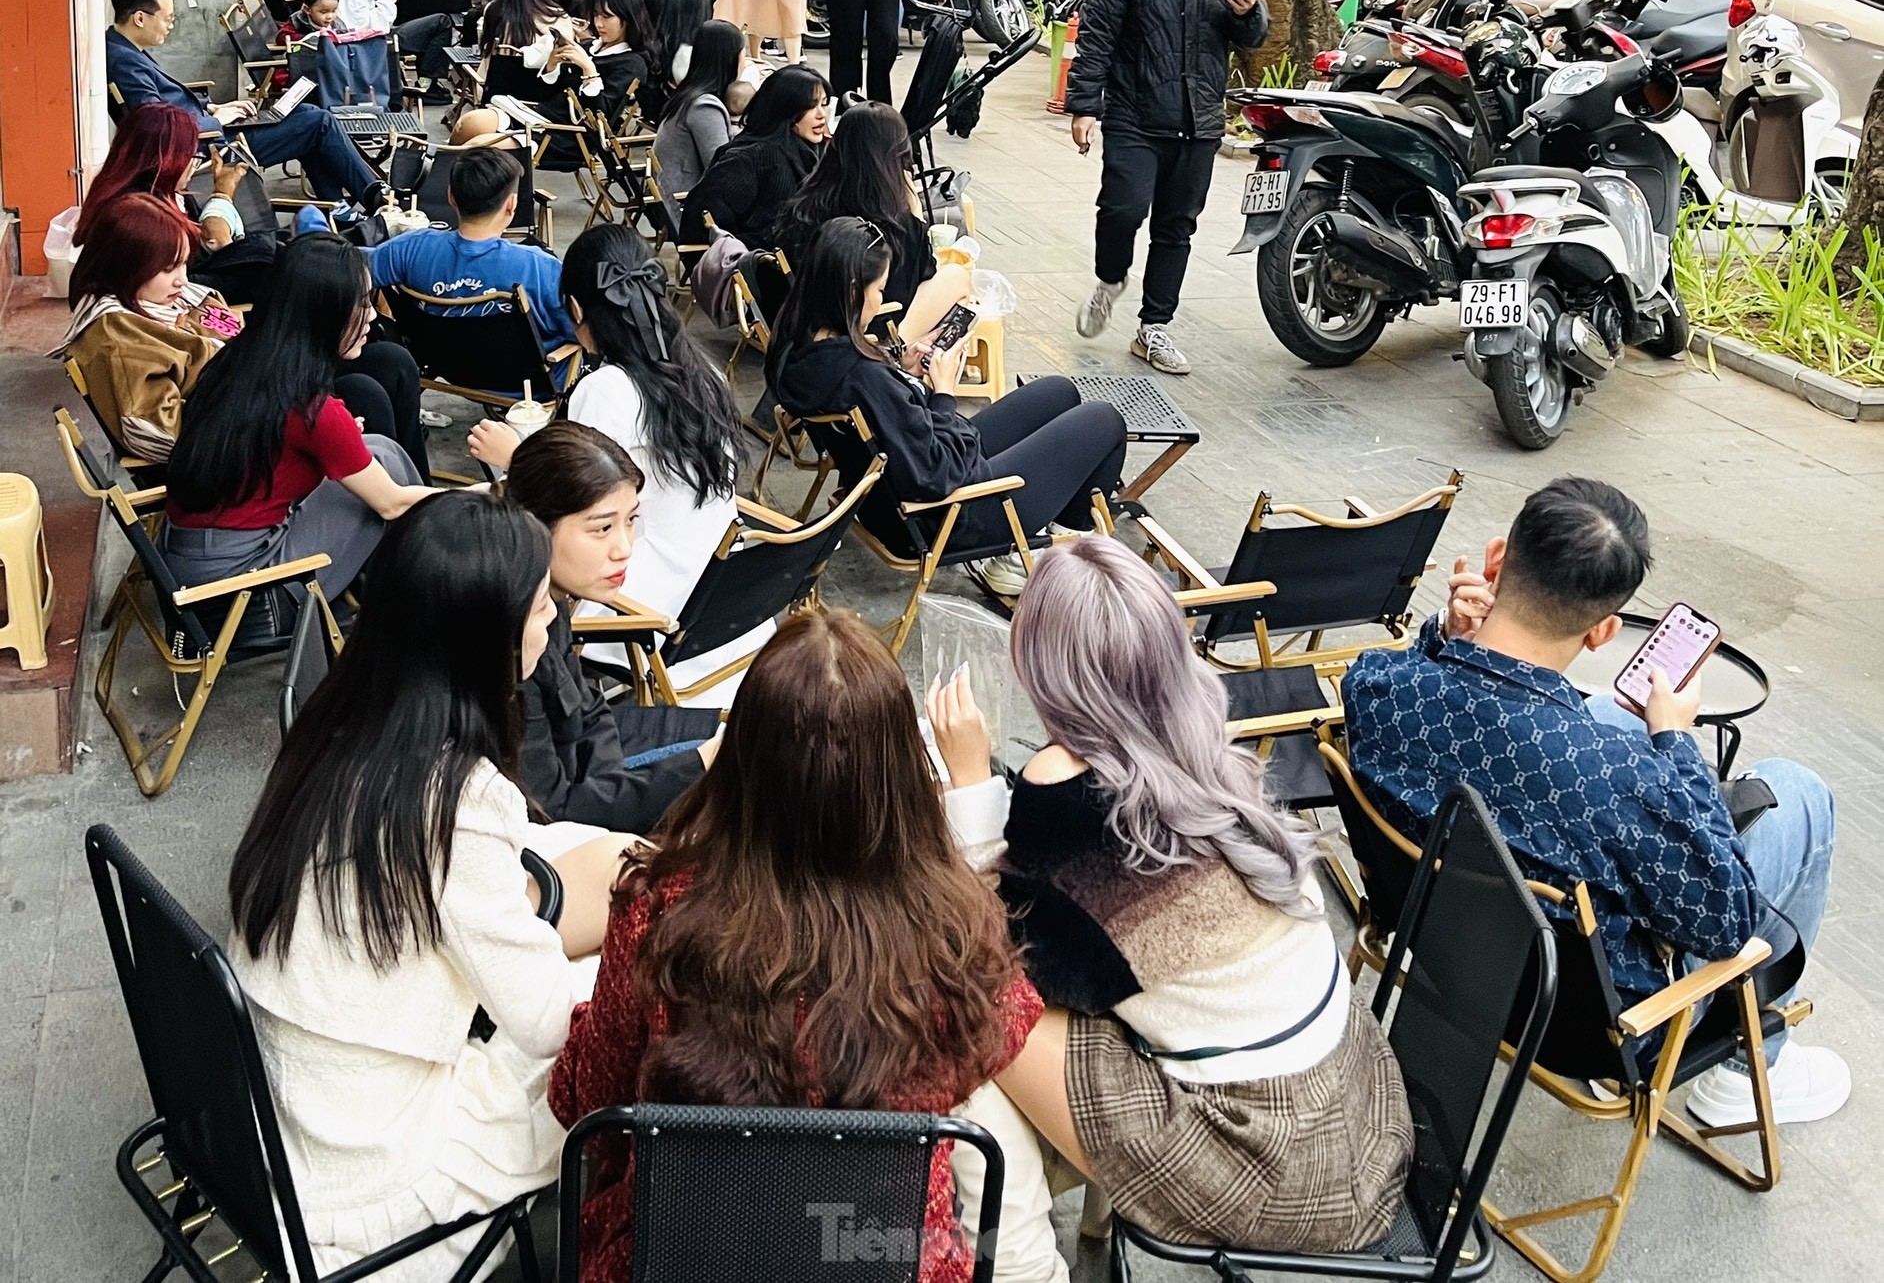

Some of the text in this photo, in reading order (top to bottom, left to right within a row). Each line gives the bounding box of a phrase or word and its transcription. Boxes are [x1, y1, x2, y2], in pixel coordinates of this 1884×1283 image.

[1250, 173, 1281, 192] 29-H1
[1243, 191, 1282, 212] 717.95
[1470, 283, 1516, 303] 29-F1
[1464, 304, 1522, 325] 046.98
